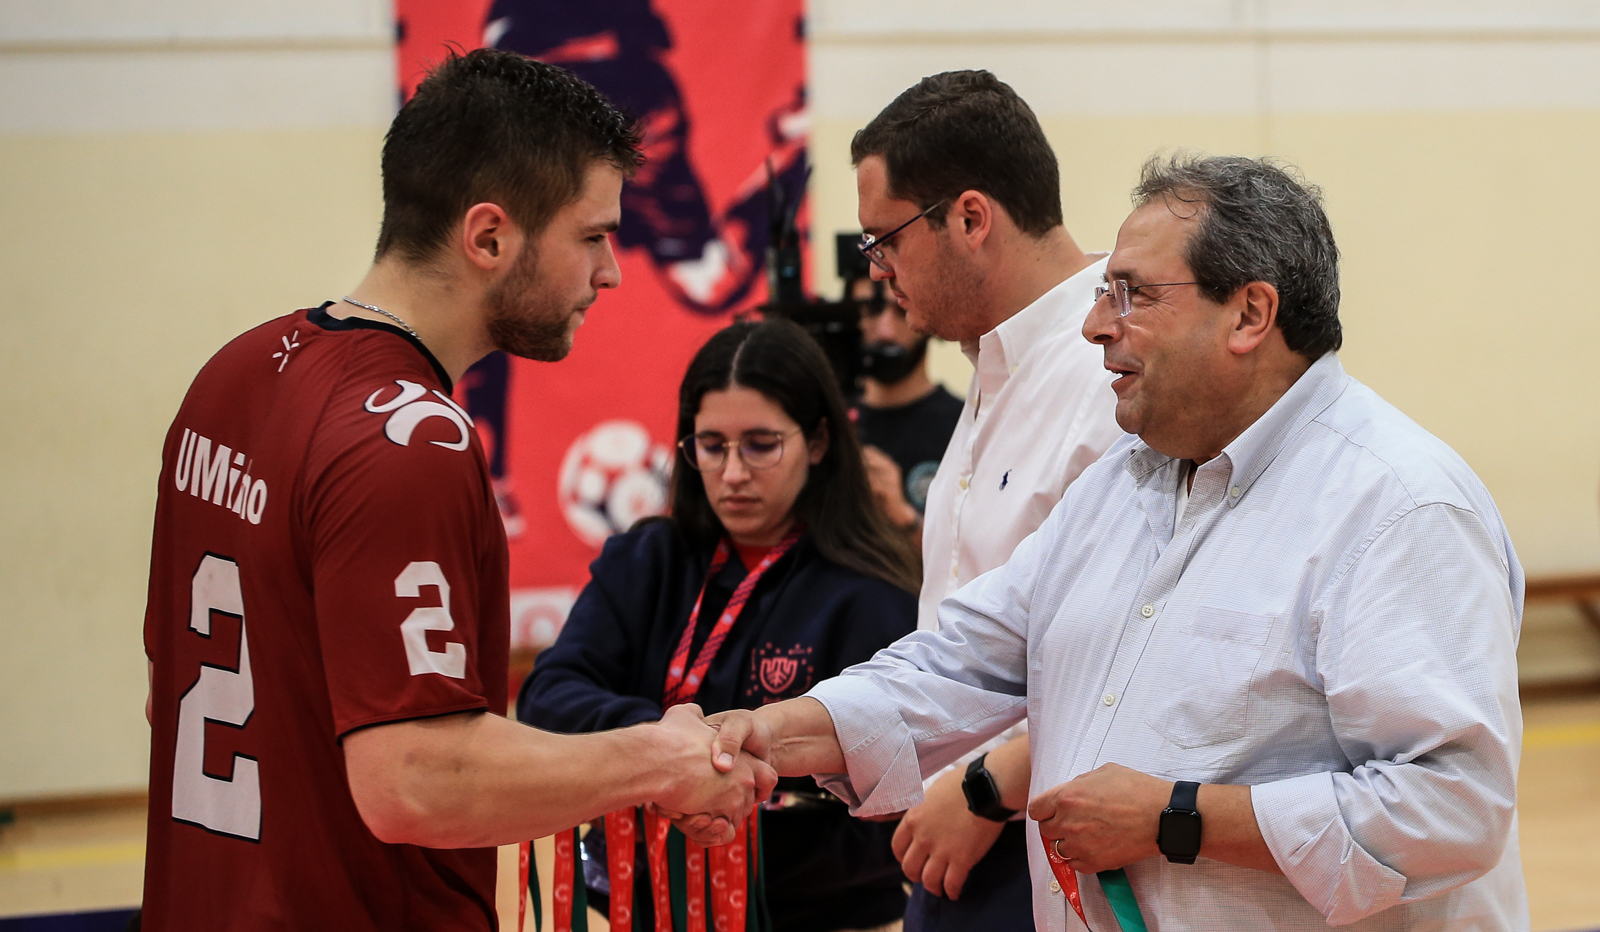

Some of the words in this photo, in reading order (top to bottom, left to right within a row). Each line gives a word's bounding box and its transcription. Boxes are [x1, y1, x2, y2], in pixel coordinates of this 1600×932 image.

[175, 427, 268, 525] UMiho
[394, 561, 467, 679] 2
[172, 551, 262, 842] 2
